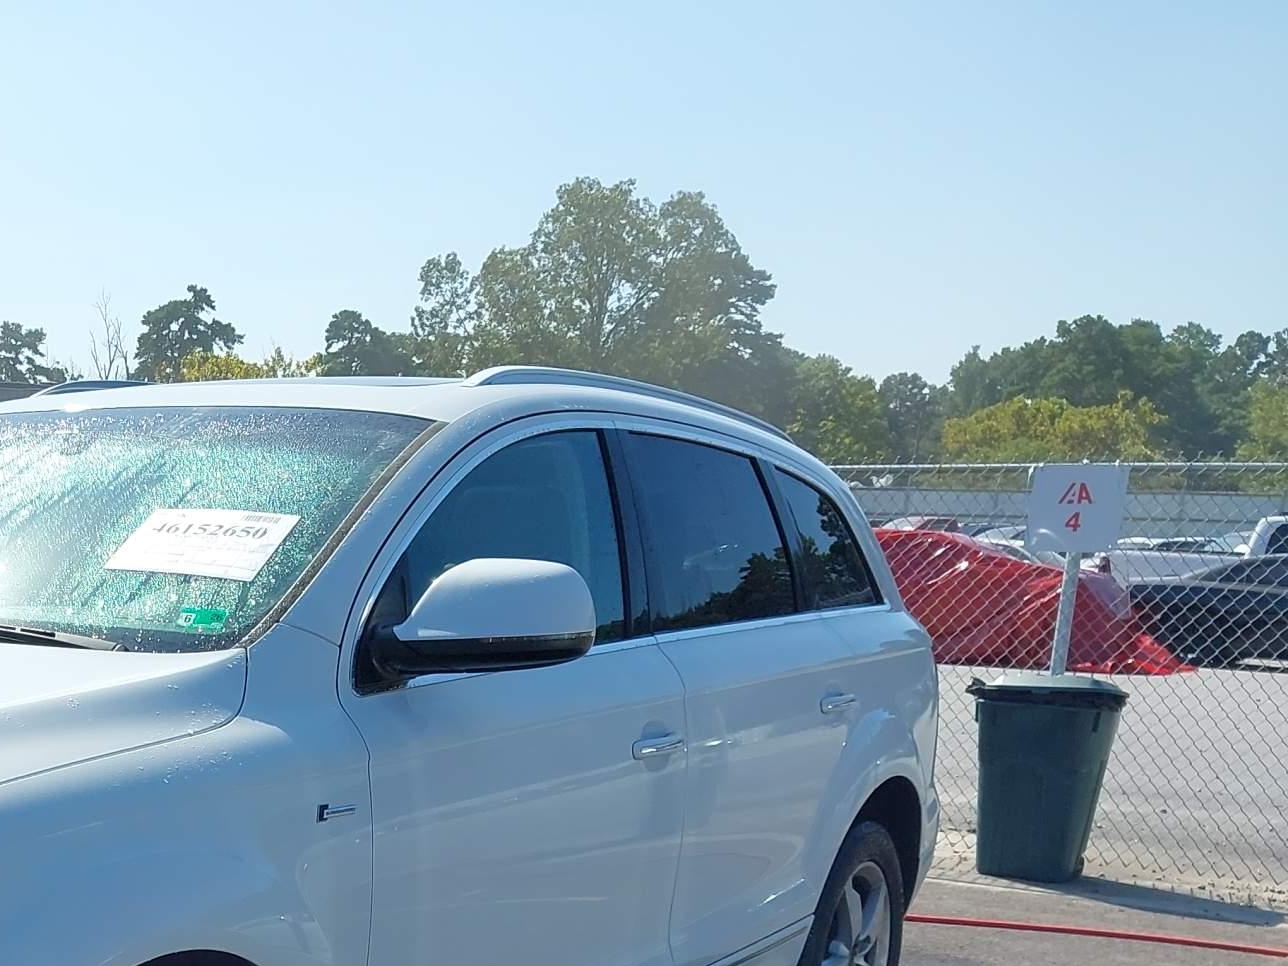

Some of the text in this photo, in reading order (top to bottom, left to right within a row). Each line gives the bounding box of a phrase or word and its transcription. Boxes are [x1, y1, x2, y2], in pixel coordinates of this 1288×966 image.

[1064, 511, 1081, 532] 4
[151, 522, 268, 540] 46152650
[183, 614, 193, 623] 6
